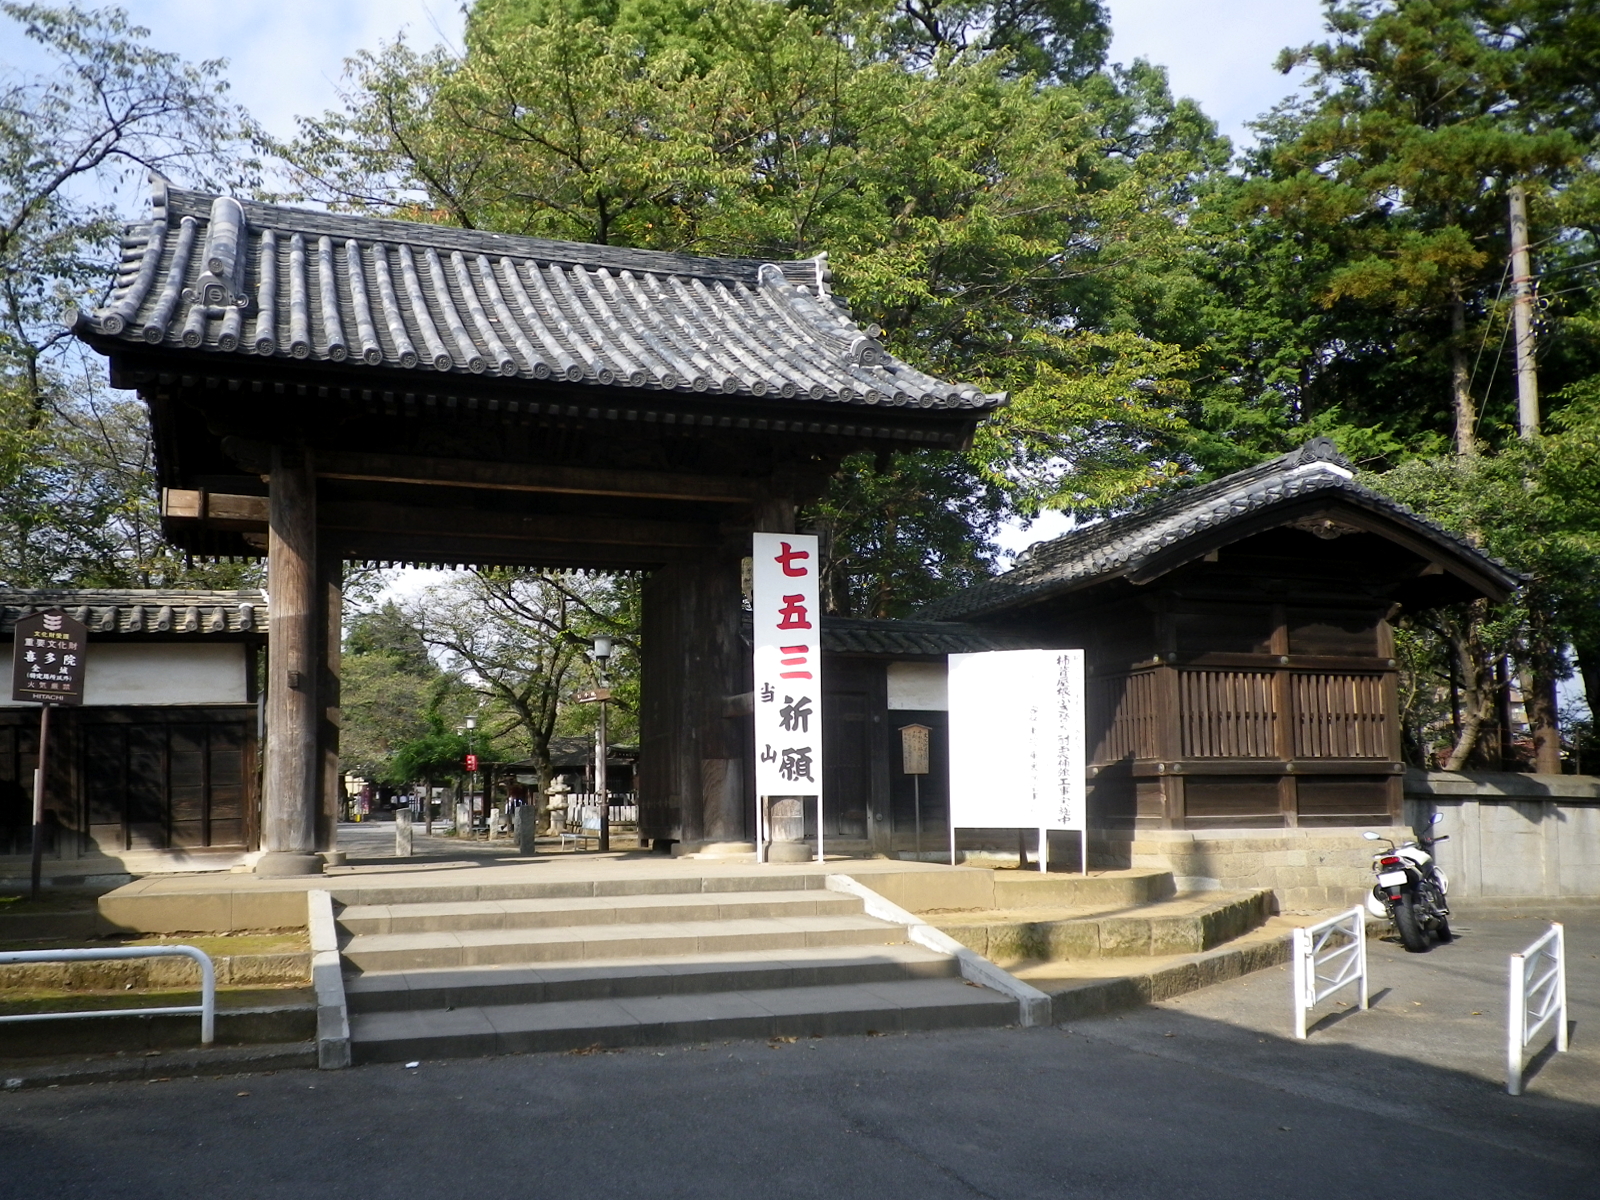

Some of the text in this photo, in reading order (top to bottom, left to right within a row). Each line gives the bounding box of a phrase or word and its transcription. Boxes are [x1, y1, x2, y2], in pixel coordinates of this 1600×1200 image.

[33, 631, 70, 640] 文化財愛護
[24, 638, 78, 650] 重要文化財
[24, 650, 76, 666] 喜多院
[774, 541, 815, 783] 七五三祈願
[27, 681, 71, 691] 火気厳禁
[32, 693, 64, 701] HITACHI
[760, 682, 777, 763] 当山
